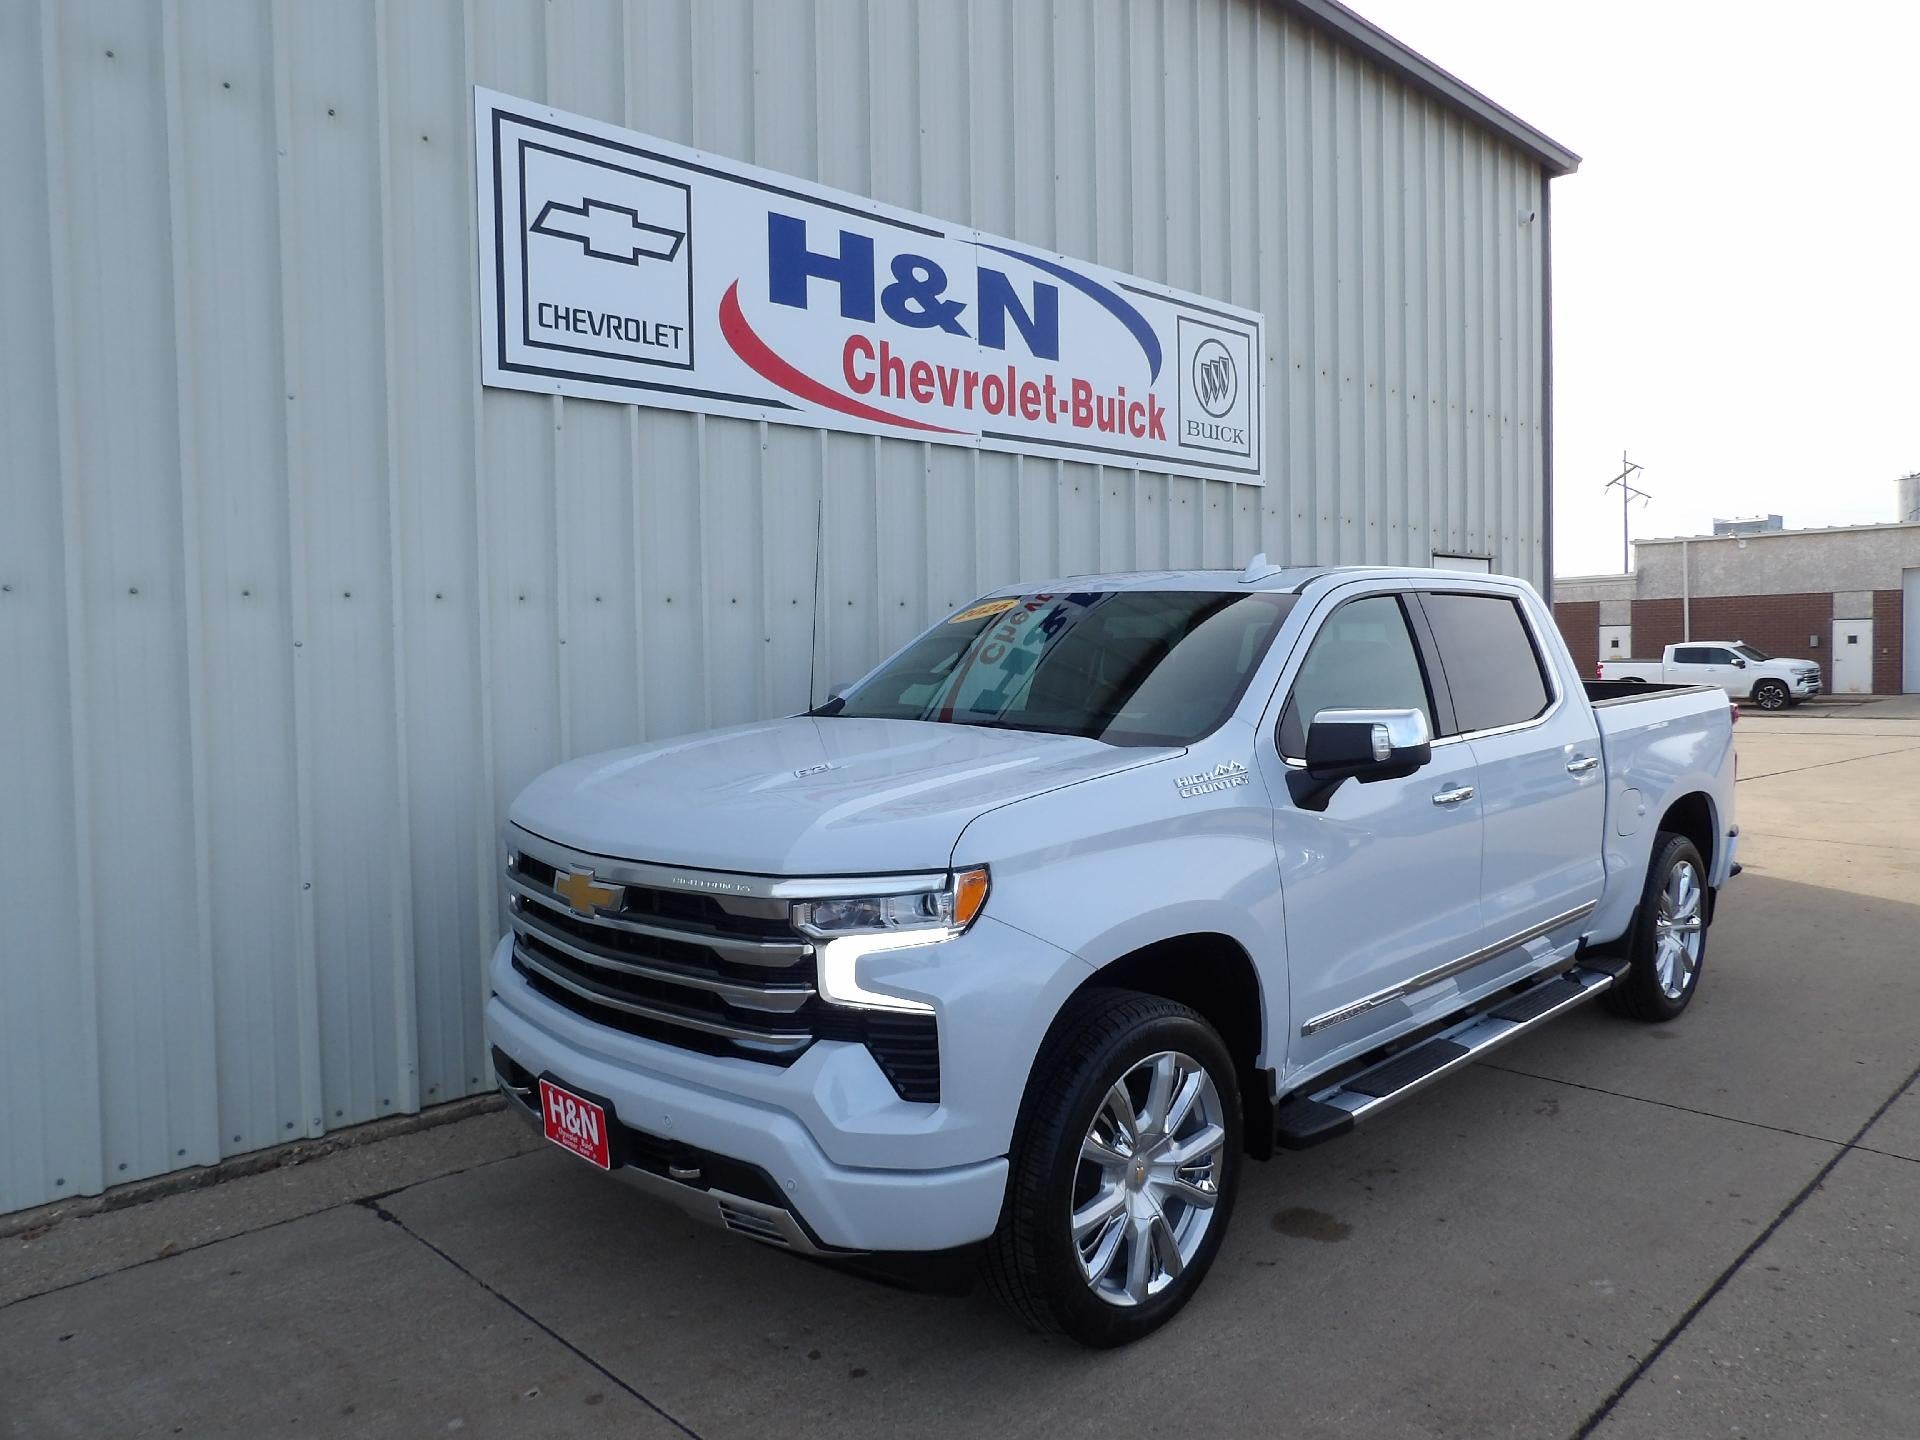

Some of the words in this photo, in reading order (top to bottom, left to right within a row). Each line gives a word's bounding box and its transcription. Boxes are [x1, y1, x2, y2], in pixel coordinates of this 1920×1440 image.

[768, 211, 1059, 361] H&N
[538, 302, 684, 350] CHEVROLET
[843, 335, 1167, 441] Chevrolet-Buick
[1186, 420, 1245, 445] BUICK
[1174, 771, 1215, 788] HIGH
[1180, 775, 1250, 799] COUNTRY
[548, 1088, 599, 1146] H&N
